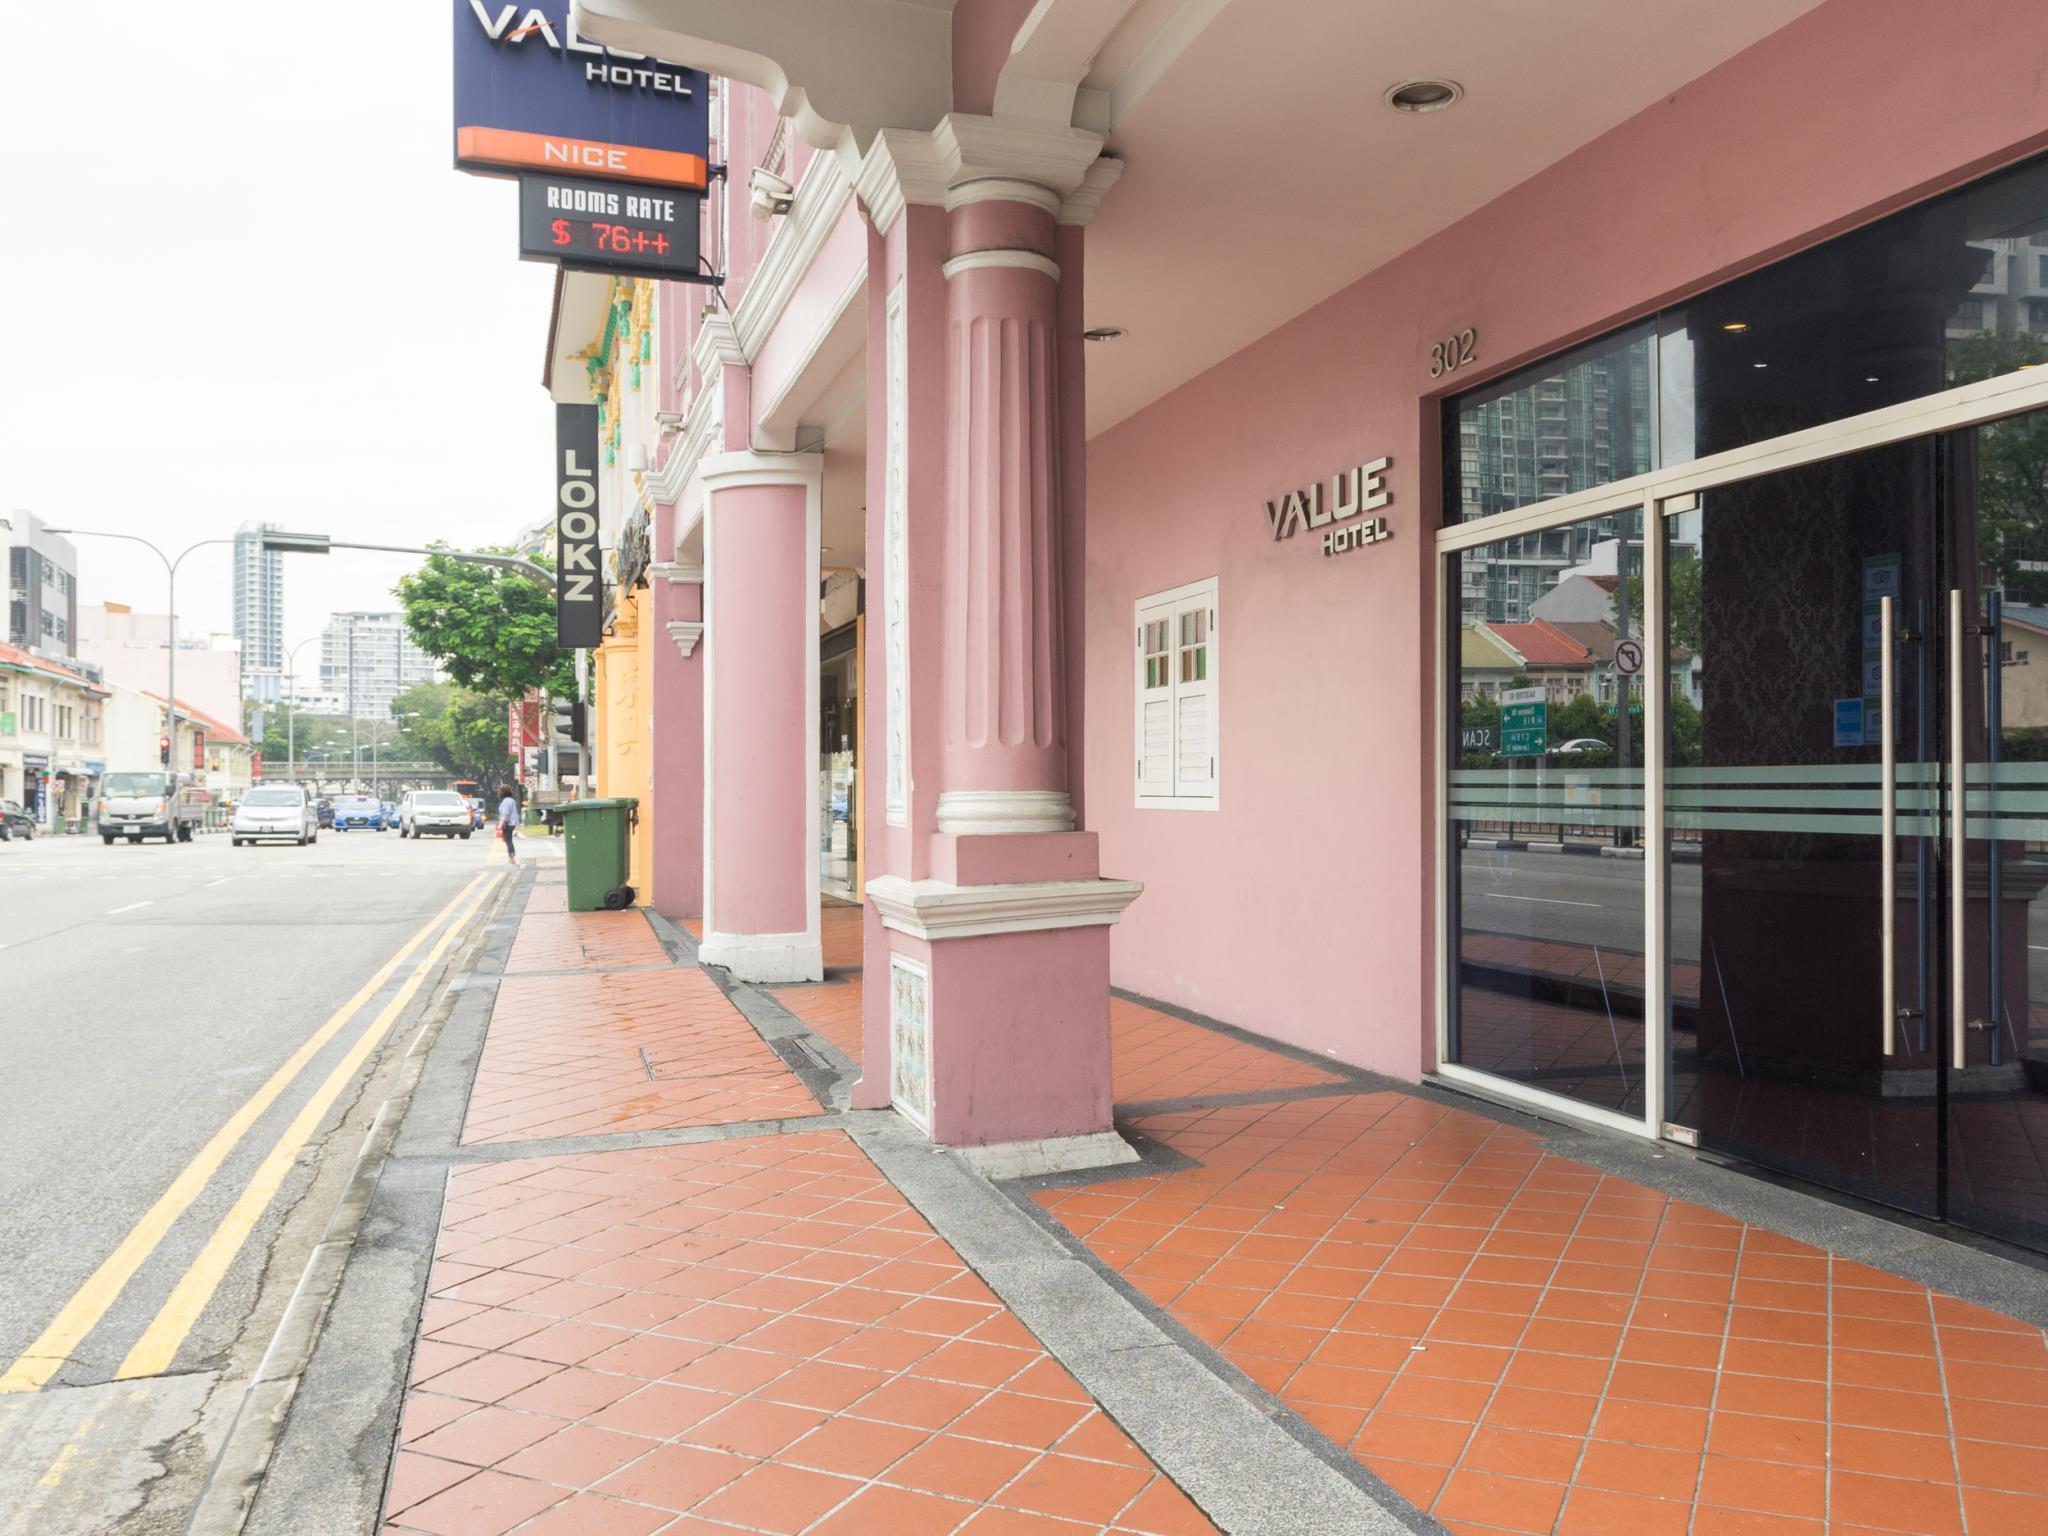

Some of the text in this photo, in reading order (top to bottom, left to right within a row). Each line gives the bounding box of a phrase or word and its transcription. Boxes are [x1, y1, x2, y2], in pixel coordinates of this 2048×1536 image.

[469, 0, 684, 65] VAL
[586, 62, 692, 95] HOTEL
[544, 141, 628, 170] NICE
[547, 186, 675, 222] ROOMS RATE
[551, 218, 670, 254] $ 76++
[1430, 328, 1476, 379] 302
[1265, 456, 1392, 541] VALUE
[560, 449, 596, 602] LOOKZ
[1321, 517, 1391, 556] HOTEL
